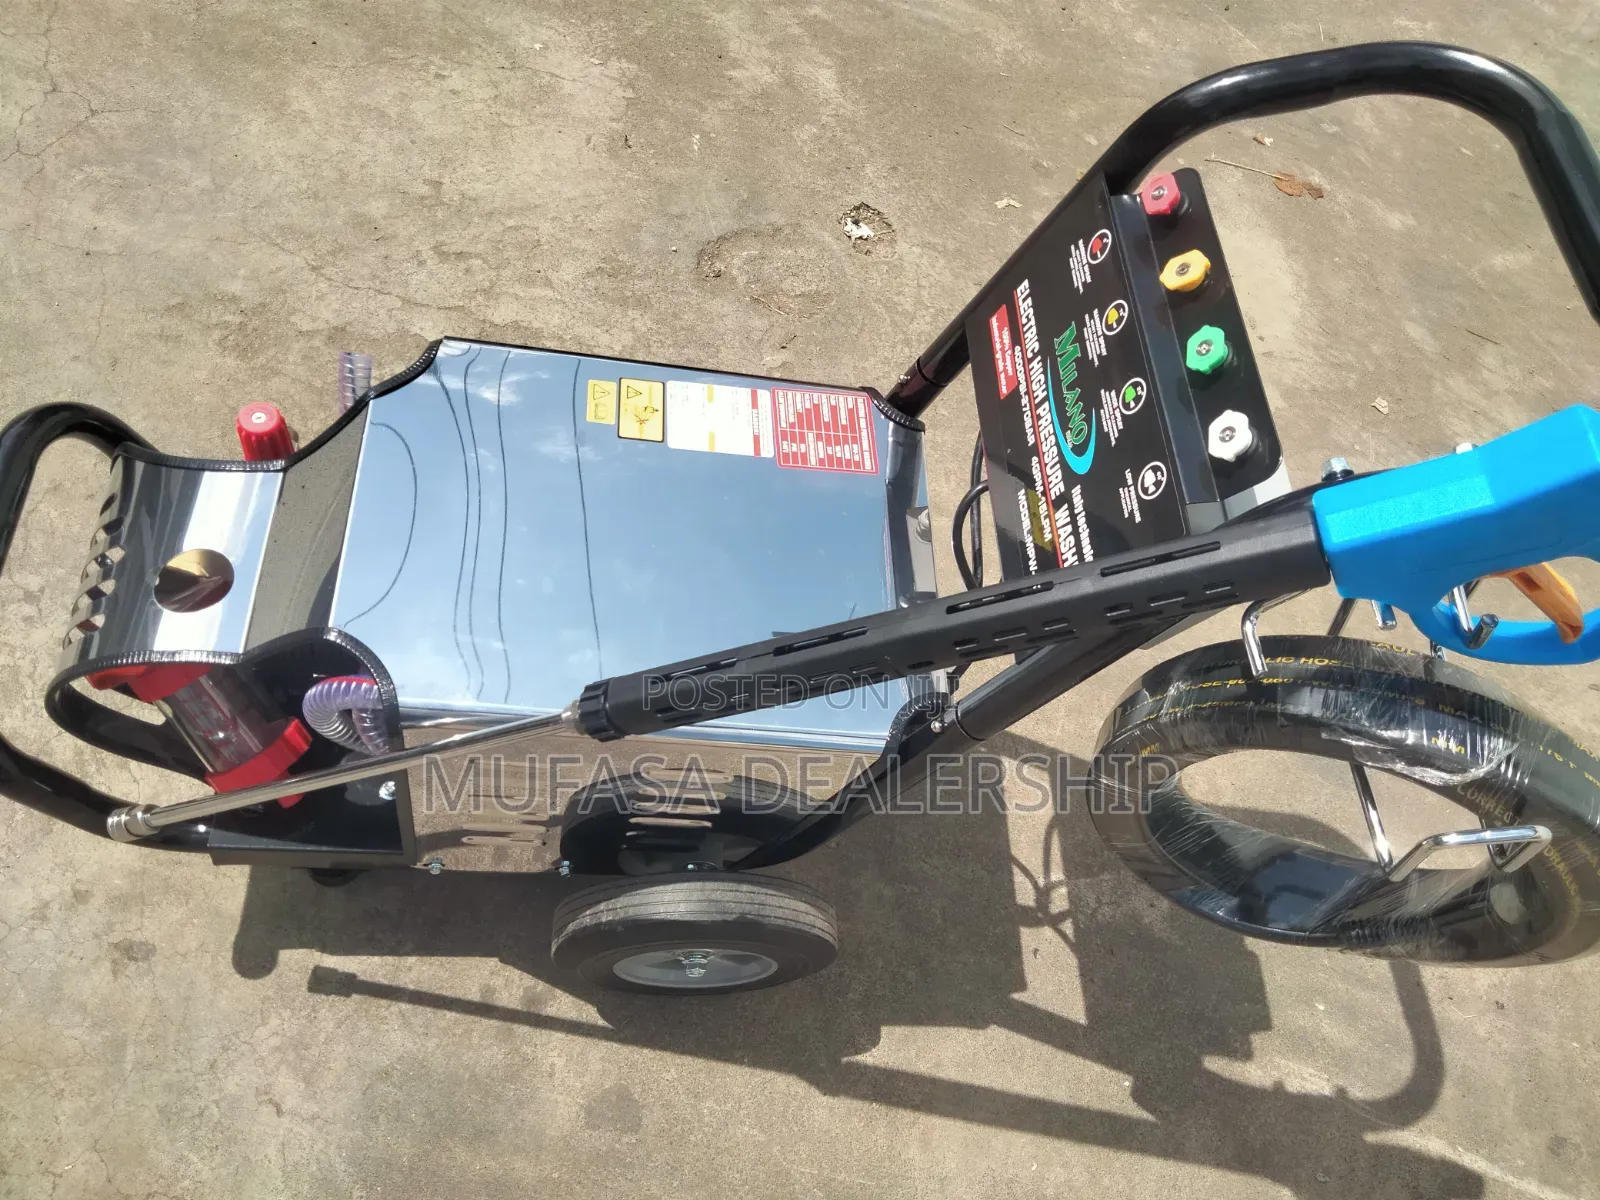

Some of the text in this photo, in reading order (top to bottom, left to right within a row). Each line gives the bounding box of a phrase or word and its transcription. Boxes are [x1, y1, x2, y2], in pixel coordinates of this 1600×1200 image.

[1001, 326, 1013, 376] 100% Copper
[1014, 345, 1035, 446] 4000PSI-270BAR
[1053, 320, 1088, 445] MILANO
[1016, 278, 1078, 567] ELECTRIC HIGH PRESSURE WASH
[1113, 407, 1123, 429] SPRAY
[1071, 484, 1083, 513] Italy
[1124, 468, 1141, 523] LOW PRESSURE
